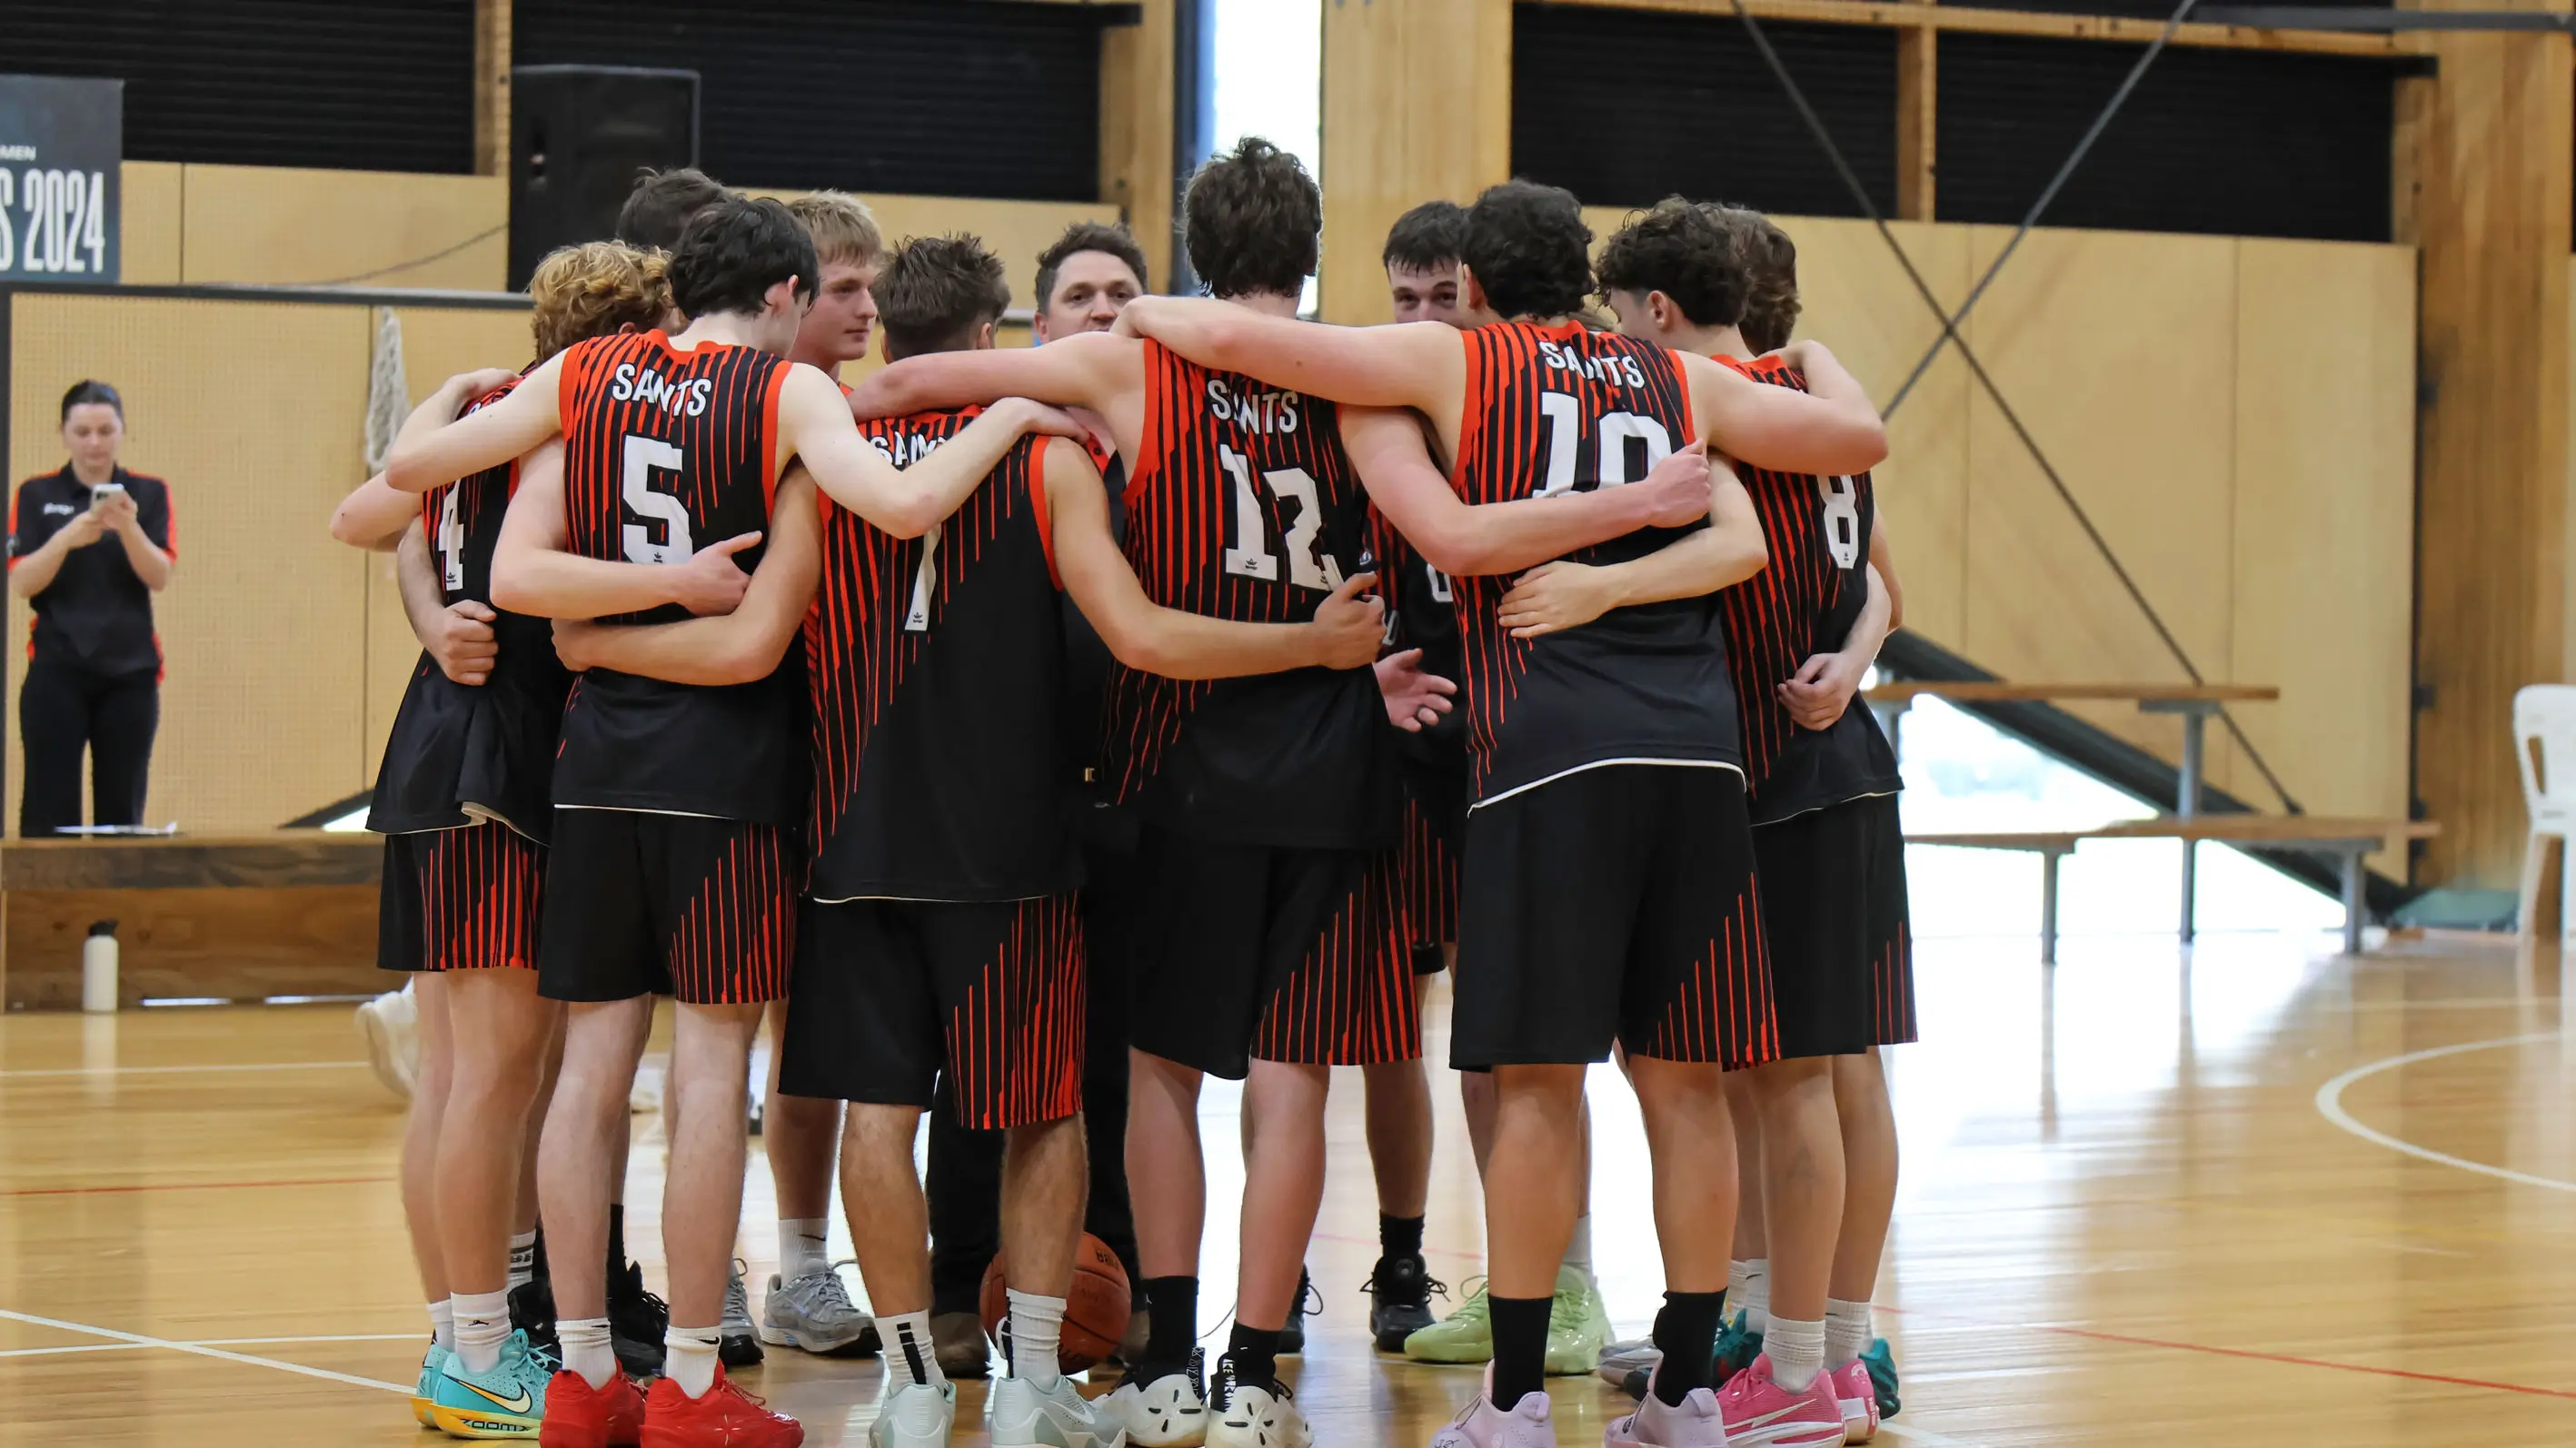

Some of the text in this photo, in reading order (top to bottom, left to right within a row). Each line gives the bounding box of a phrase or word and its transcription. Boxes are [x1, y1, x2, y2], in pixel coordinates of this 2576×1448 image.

[24, 168, 105, 273] 2024
[612, 363, 712, 417] SANTS
[1538, 341, 1646, 389] SANTS
[1533, 392, 1674, 500] 10
[438, 477, 465, 591] 4
[622, 434, 694, 565] 5
[1219, 443, 1345, 592] 12
[1815, 474, 1859, 570] 8
